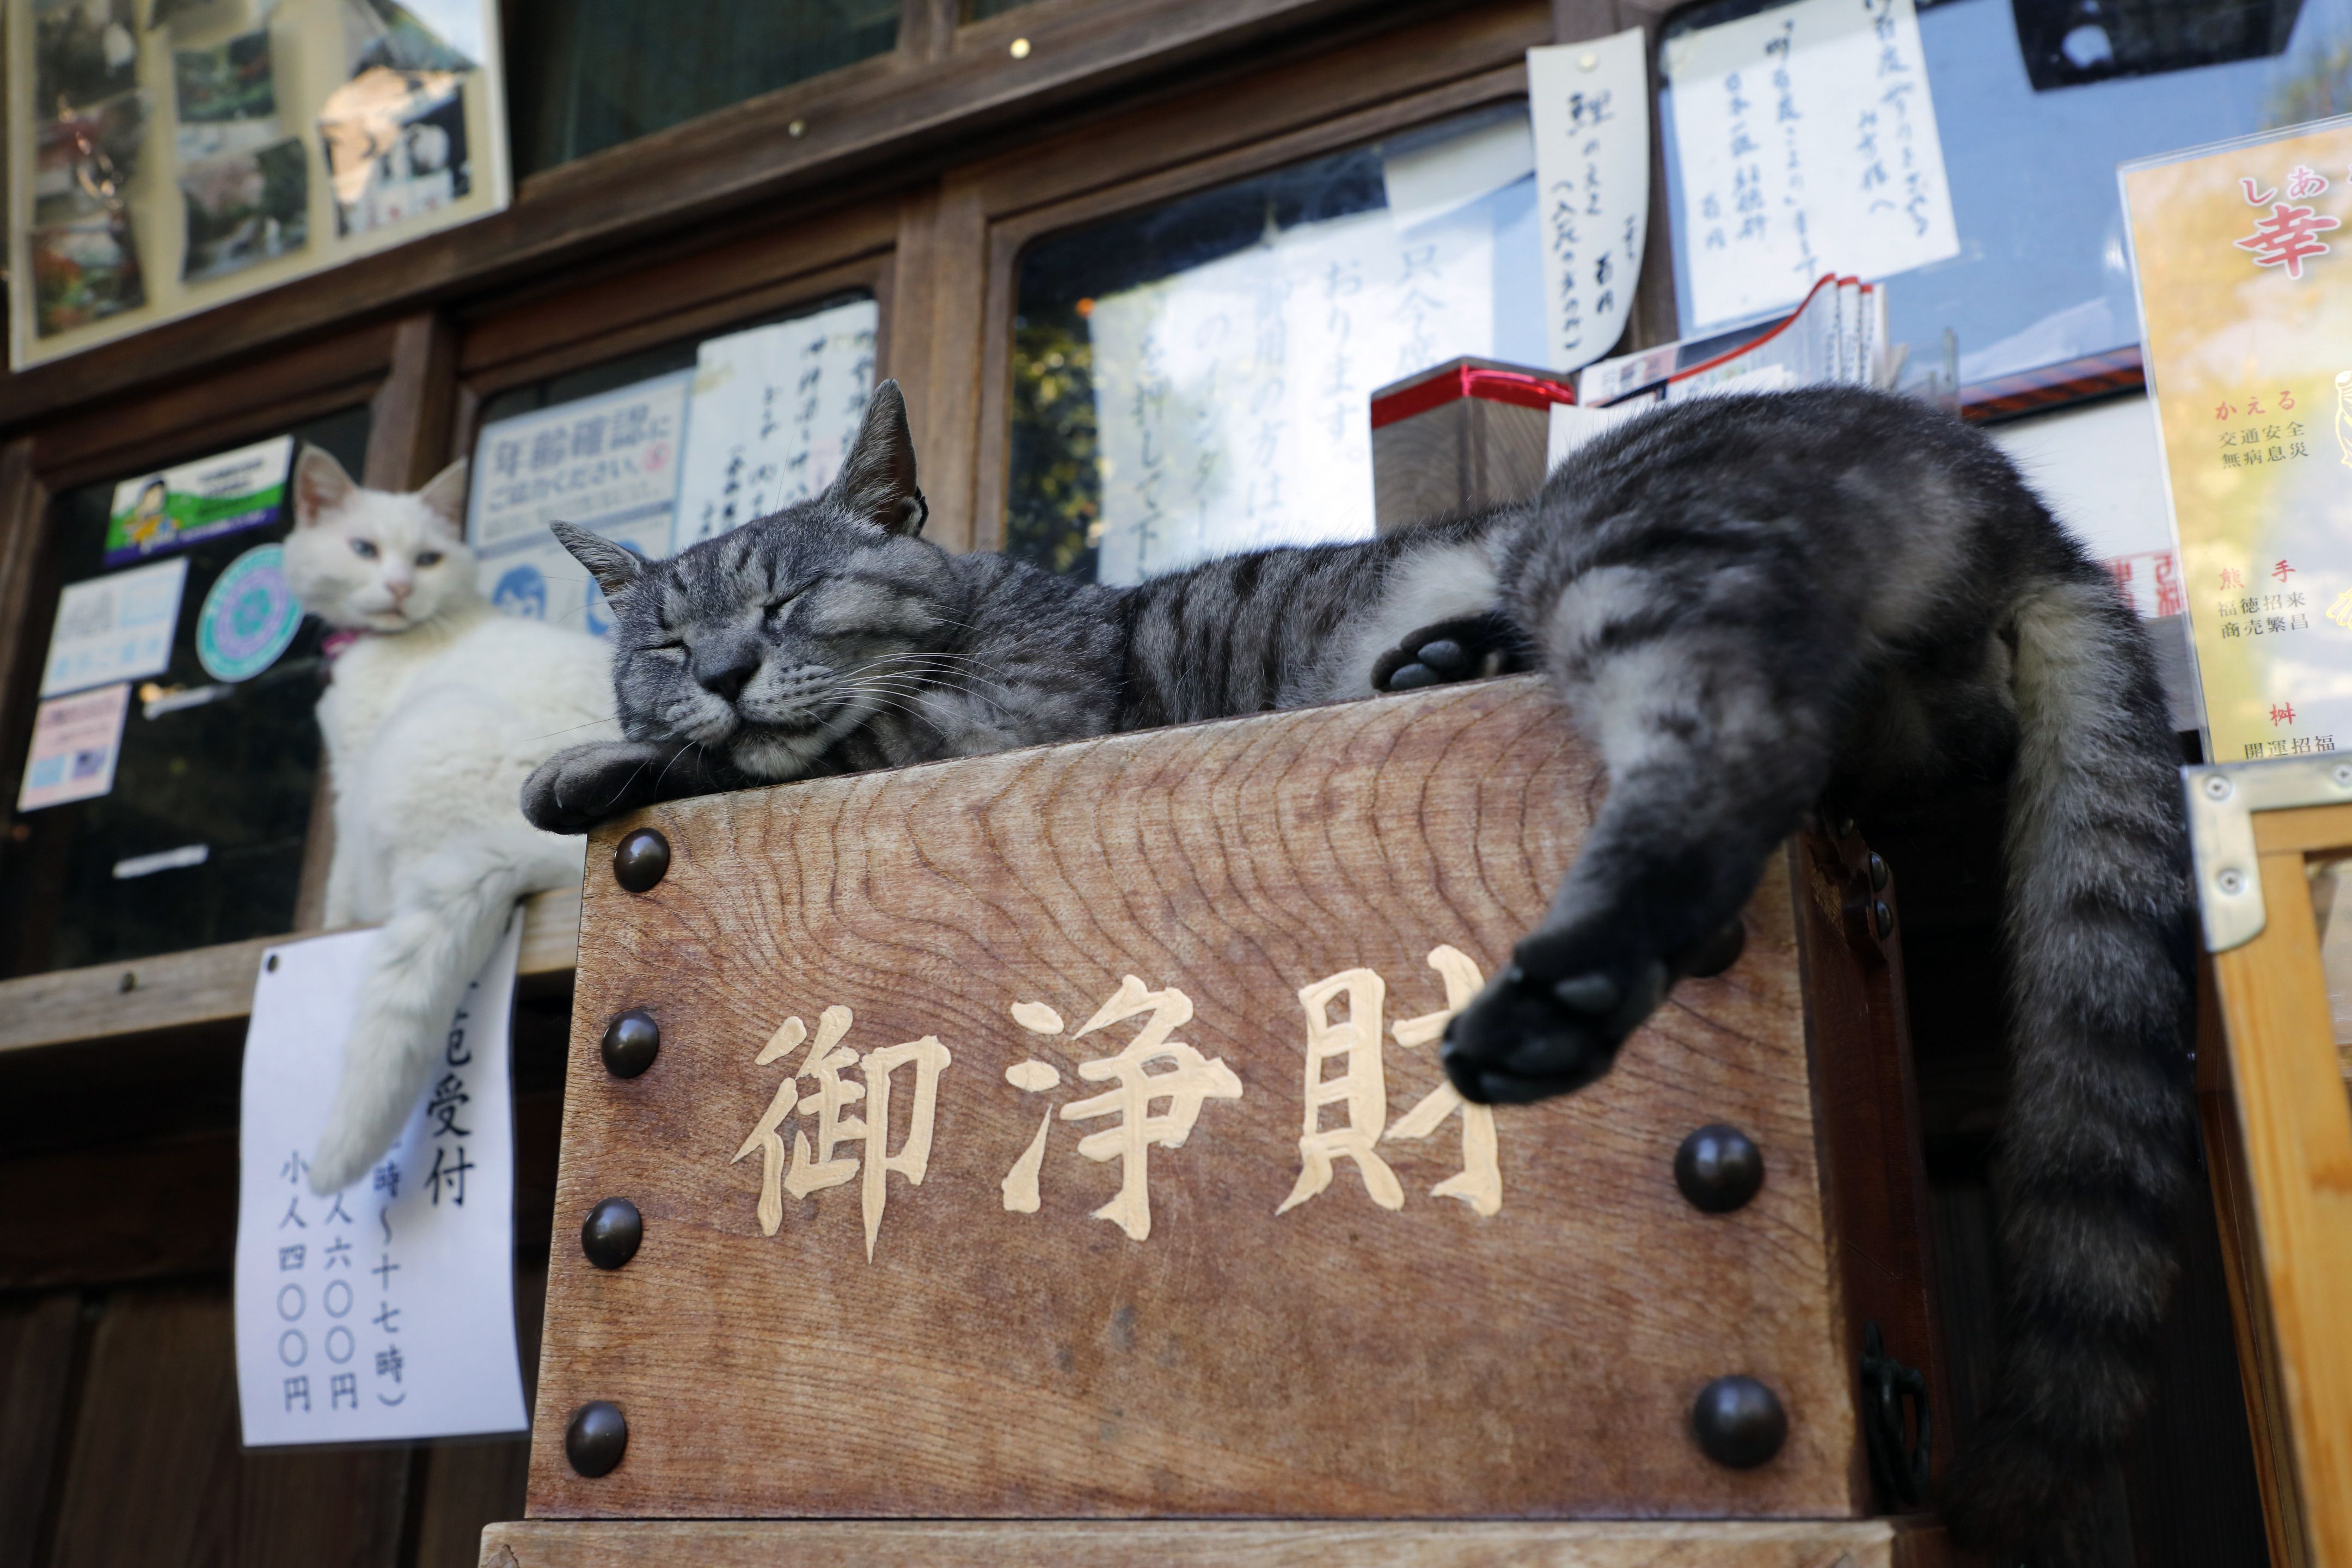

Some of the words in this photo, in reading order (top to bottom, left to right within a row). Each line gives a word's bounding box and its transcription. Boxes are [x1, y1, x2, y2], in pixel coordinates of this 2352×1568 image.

[2243, 166, 2352, 205] しあ
[2235, 206, 2339, 278] 幸
[2215, 390, 2296, 421] かえる
[2218, 421, 2305, 449] 交通安全
[2222, 442, 2309, 469] 無病息災
[2218, 560, 2296, 592] 熊手
[2218, 591, 2306, 617] 福徳招来
[2221, 613, 2308, 639] 商売繁昌
[2244, 734, 2336, 760] 開運招福
[728, 943, 1505, 1266] 御浄財
